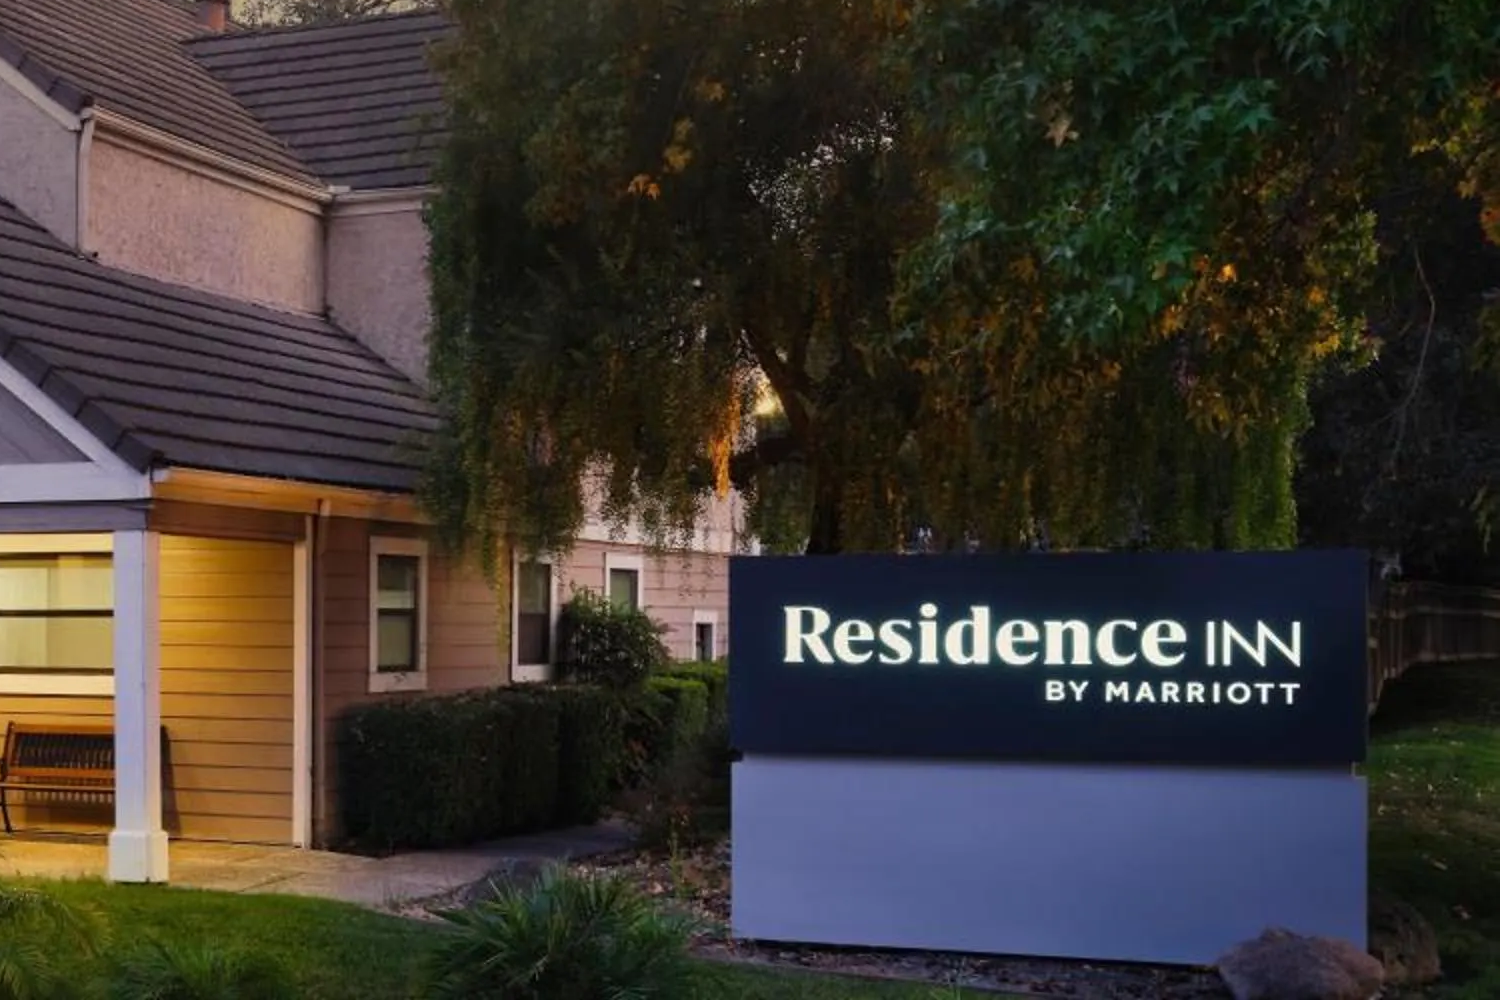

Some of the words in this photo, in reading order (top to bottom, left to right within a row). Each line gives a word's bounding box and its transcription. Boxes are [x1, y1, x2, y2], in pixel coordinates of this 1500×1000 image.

[783, 603, 1187, 667] Residence
[1206, 620, 1301, 667] INN
[1045, 680, 1089, 702] BY
[1105, 681, 1301, 705] MARRIOTT
